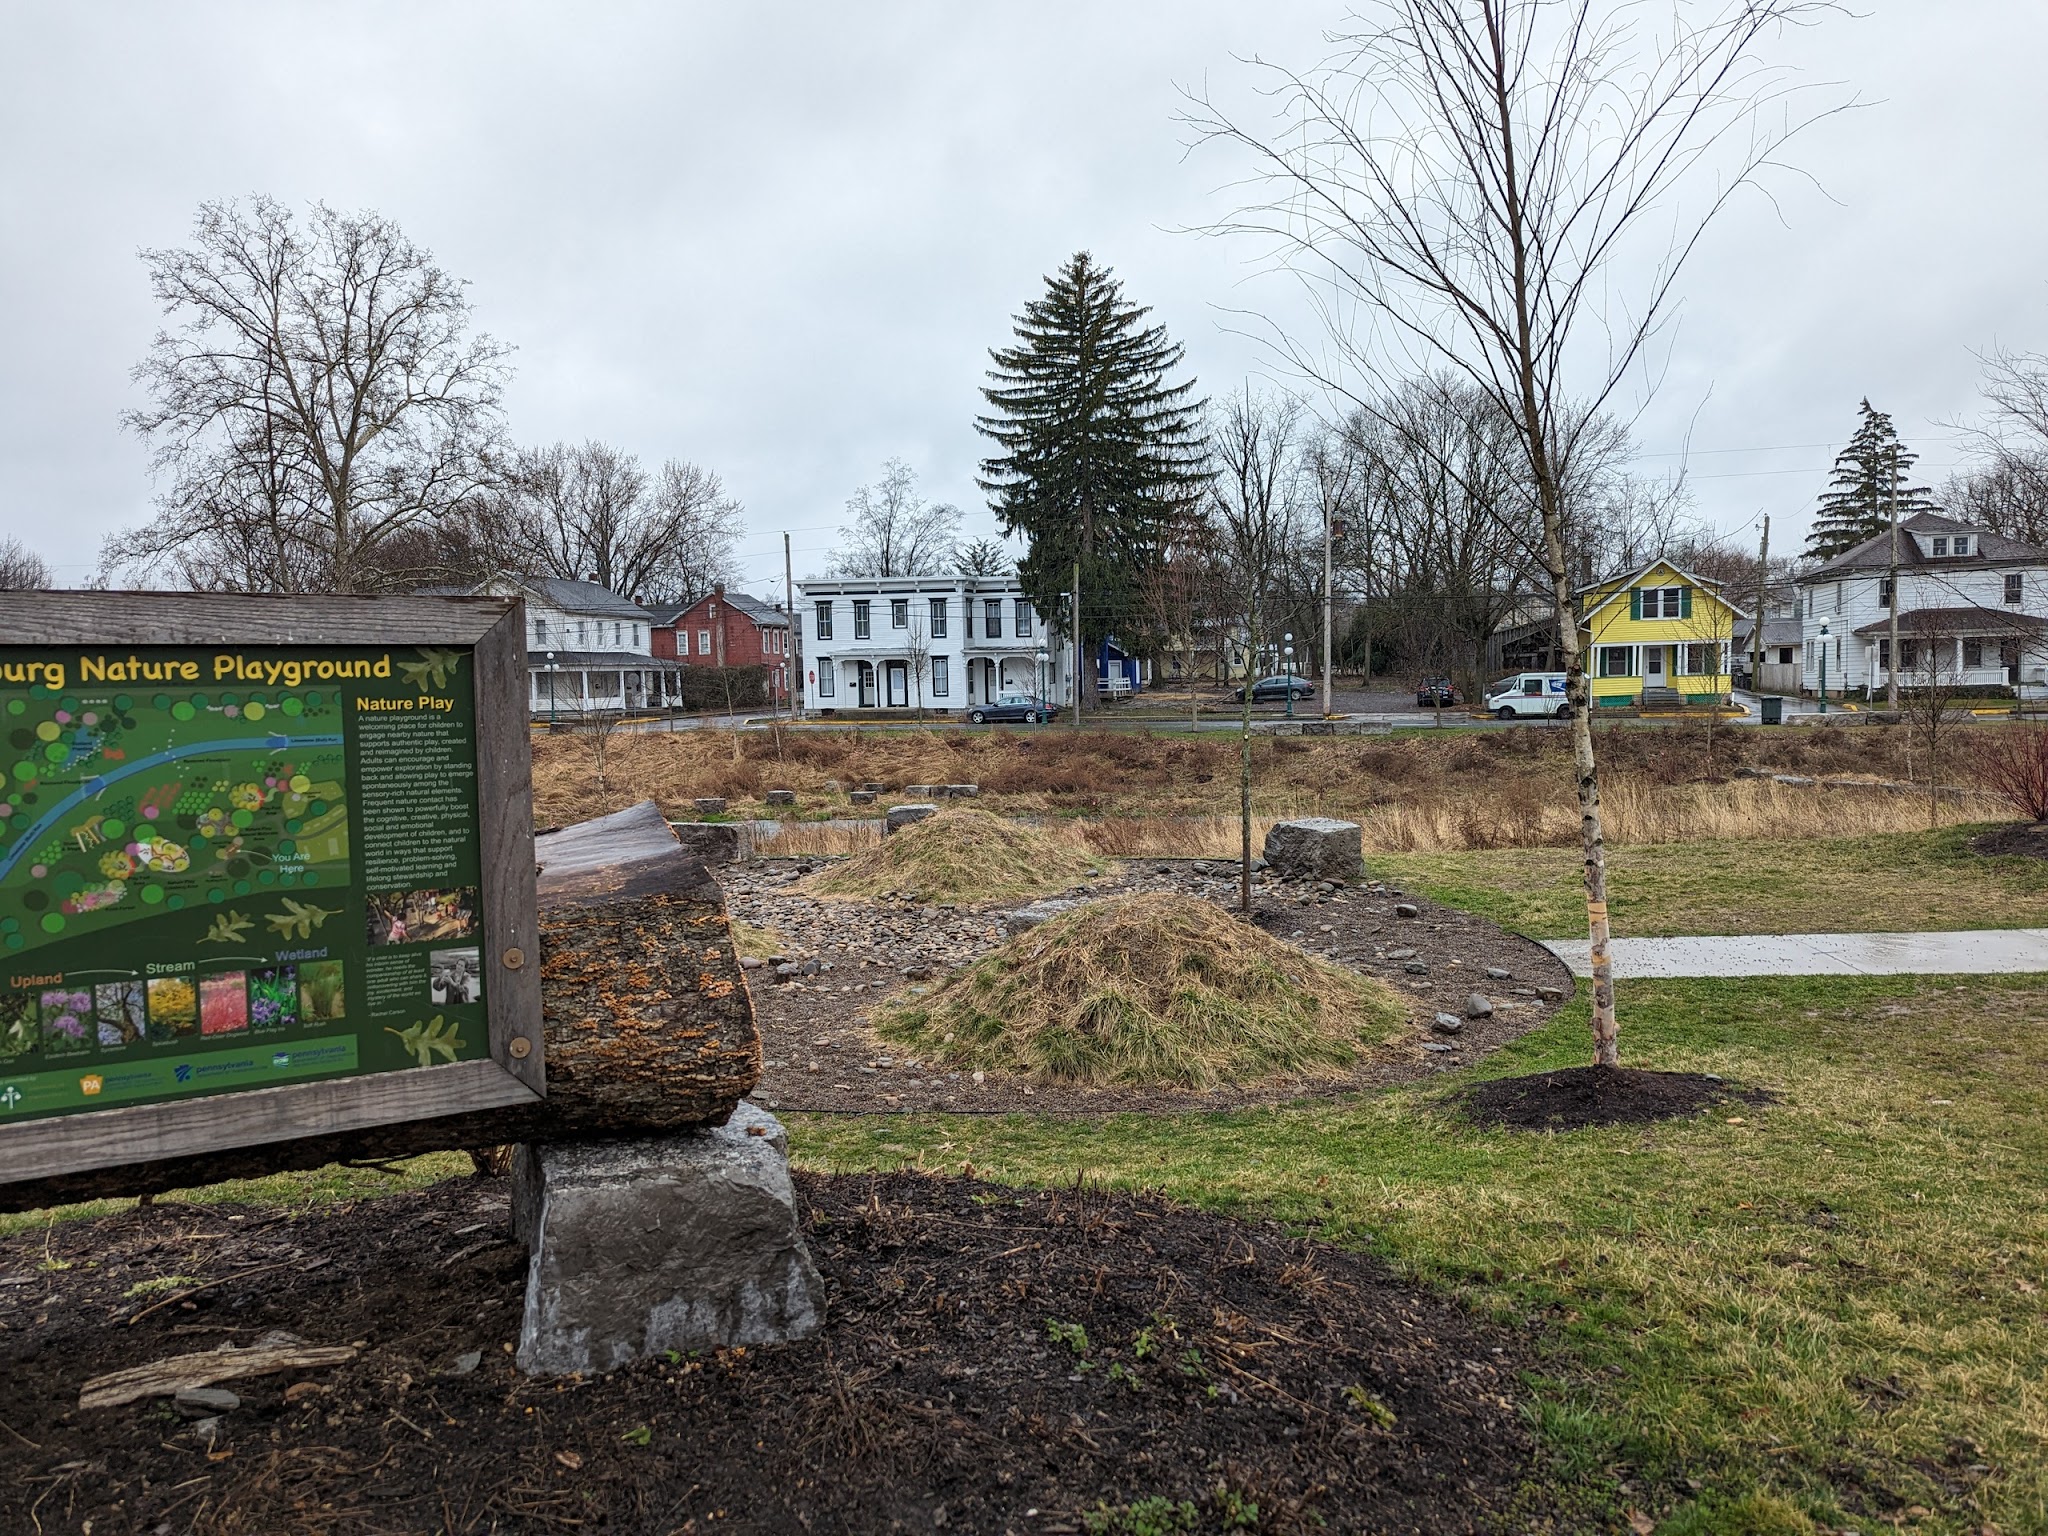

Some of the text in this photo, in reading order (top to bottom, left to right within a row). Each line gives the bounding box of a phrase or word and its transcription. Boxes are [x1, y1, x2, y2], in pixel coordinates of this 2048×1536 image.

[0, 654, 391, 690] urg Nature Playground
[357, 696, 454, 712] Nature Play
[360, 732, 385, 740] engage
[395, 764, 432, 772] exploration
[444, 762, 472, 770] standing
[362, 782, 412, 790] spontaneously
[362, 790, 405, 798] sensory-rich
[363, 799, 394, 807] Frequent
[415, 804, 449, 813] powerfully
[376, 815, 409, 824] cognitive,
[441, 812, 470, 820] physical,
[364, 832, 409, 840] development
[272, 854, 291, 862] You
[280, 865, 304, 873] Here
[366, 865, 414, 874] self-motivated
[393, 872, 434, 880] stewardship
[367, 882, 412, 891] conservation.
[275, 947, 328, 962] Wetland
[146, 961, 195, 975] Stream
[11, 972, 63, 989] Upland
[292, 1045, 346, 1061] pennsylvania
[196, 1060, 254, 1075] pennsylvania
[83, 1080, 100, 1091] PA
